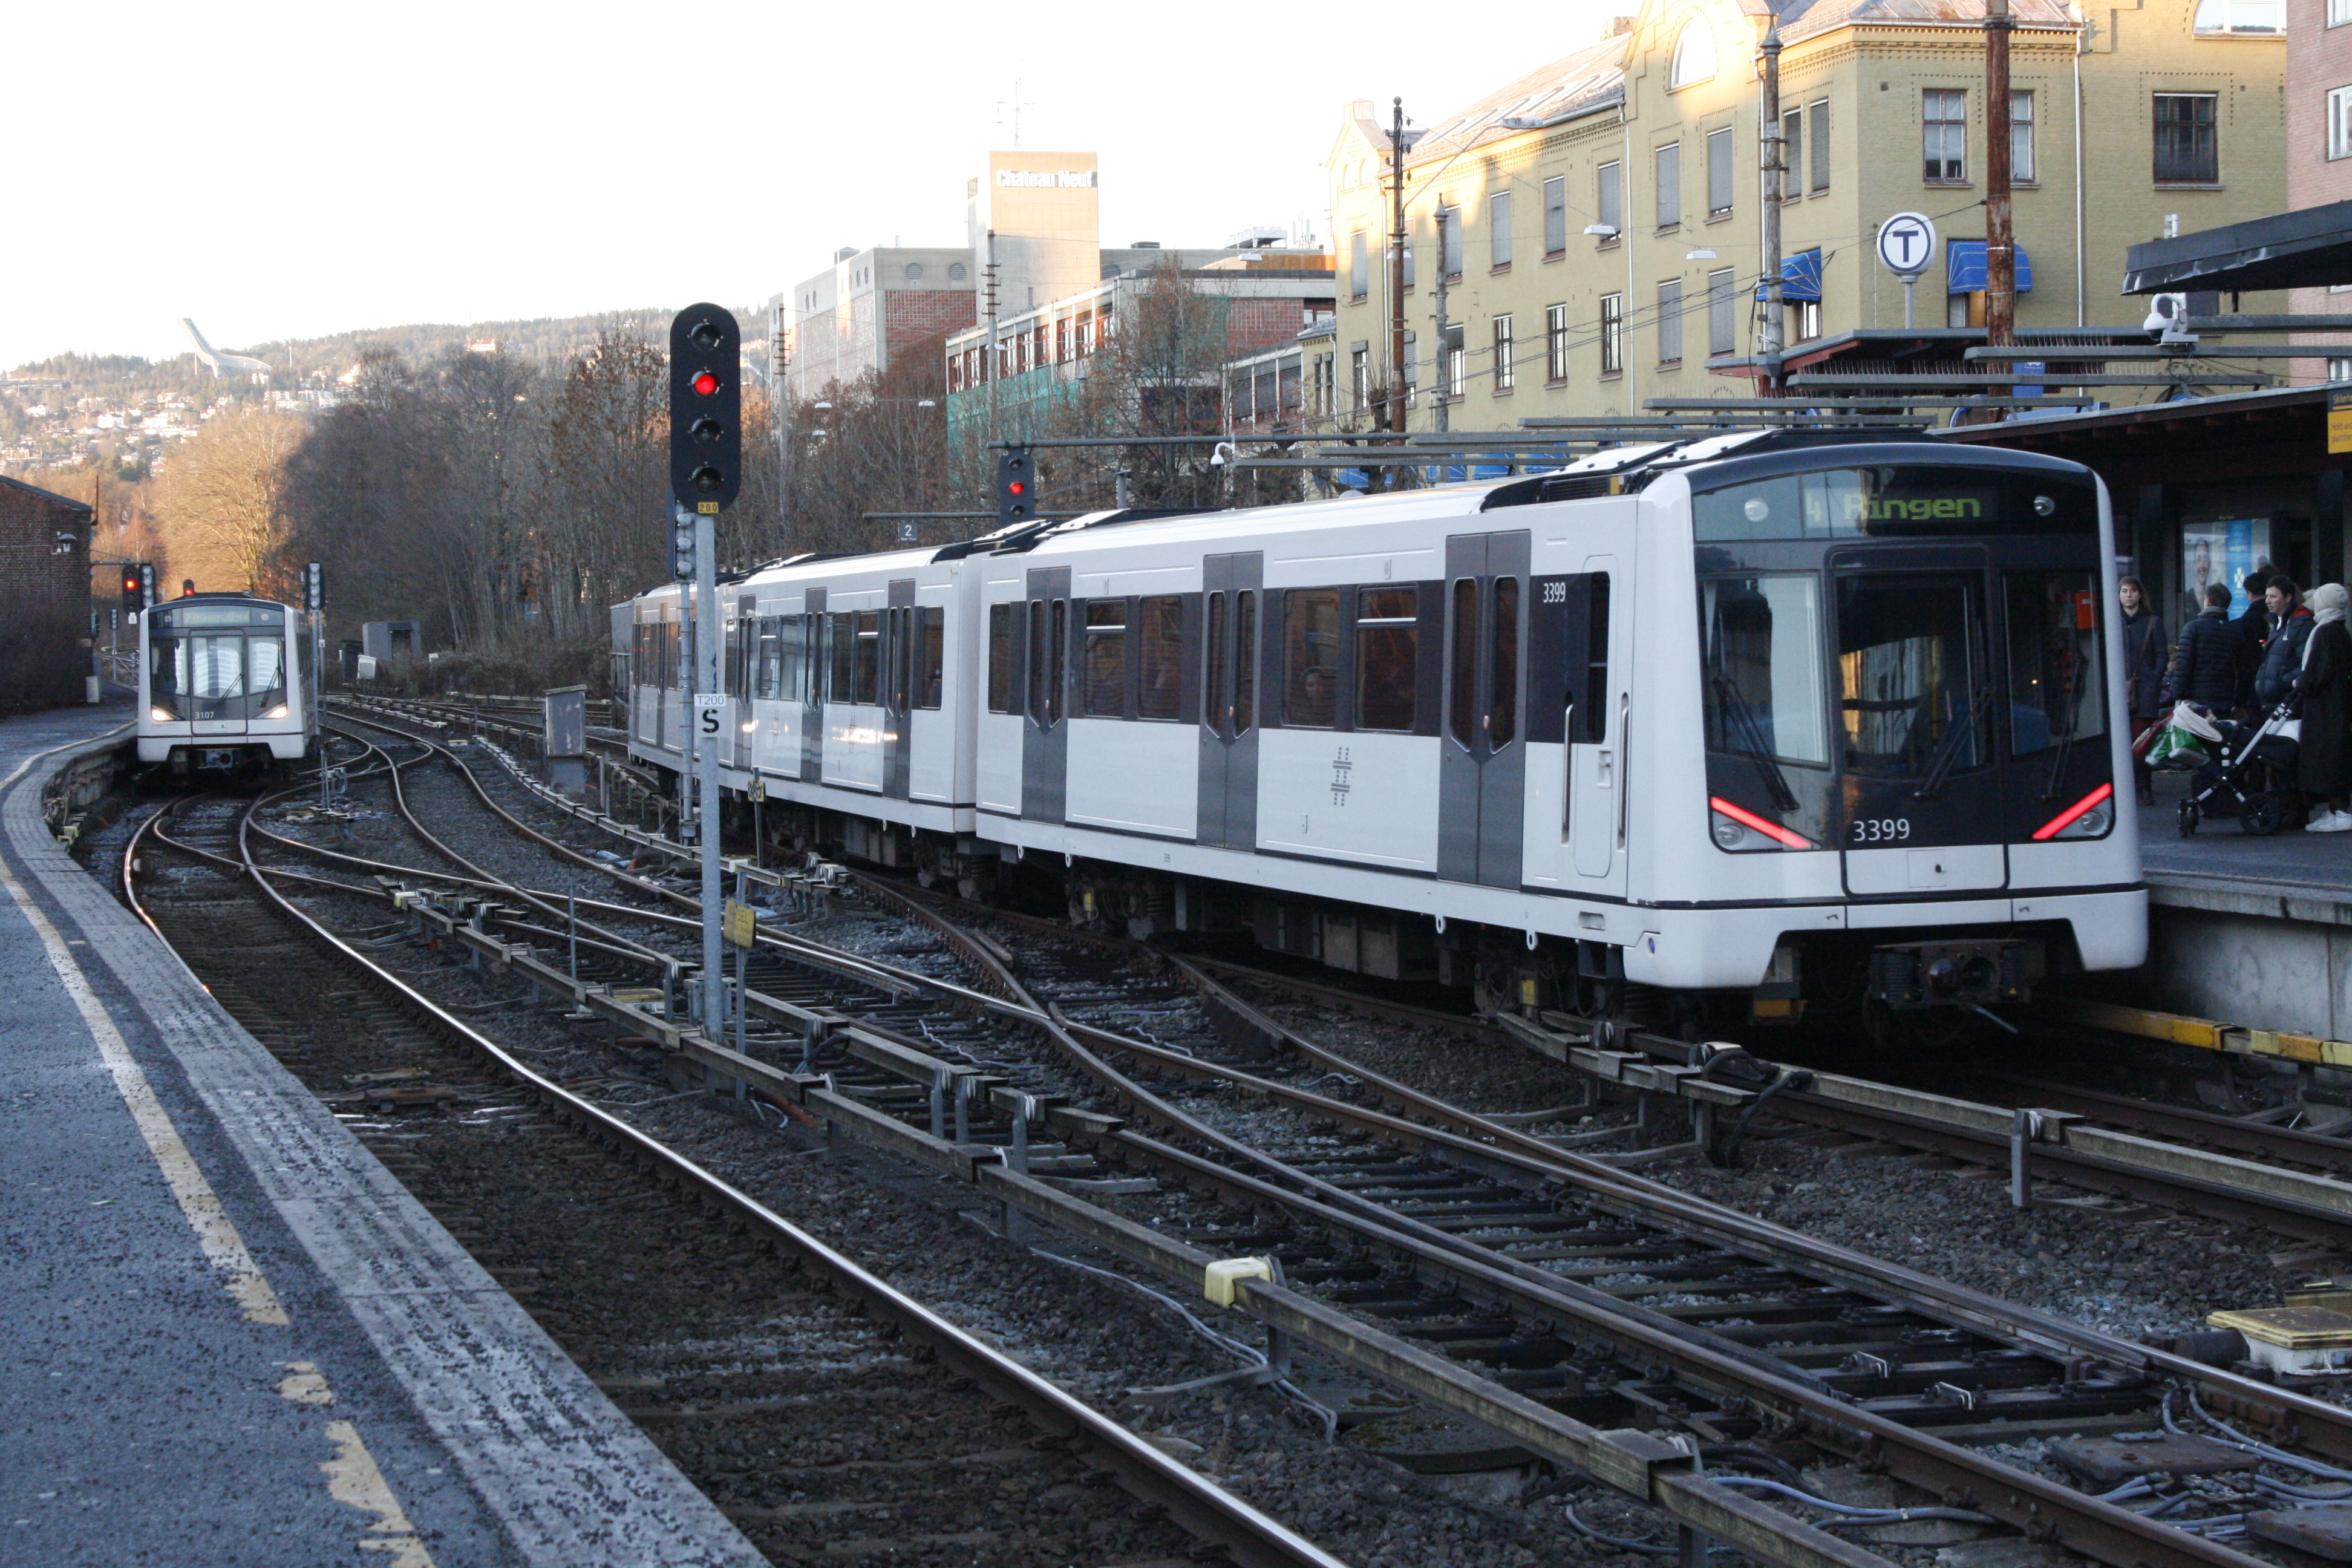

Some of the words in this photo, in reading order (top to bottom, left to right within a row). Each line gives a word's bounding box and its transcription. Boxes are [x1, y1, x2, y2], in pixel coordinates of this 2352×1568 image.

[996, 169, 1056, 187] Chateau
[1058, 170, 1093, 188] Neuf
[1893, 230, 1919, 263] T
[699, 503, 717, 512] 200
[1805, 492, 1822, 521] 4
[1841, 493, 1981, 520] Ringen
[905, 524, 912, 536] 2
[1543, 582, 1566, 603] 3399
[697, 695, 724, 705] T200
[702, 708, 719, 733] S
[1854, 818, 1910, 841] 3399
